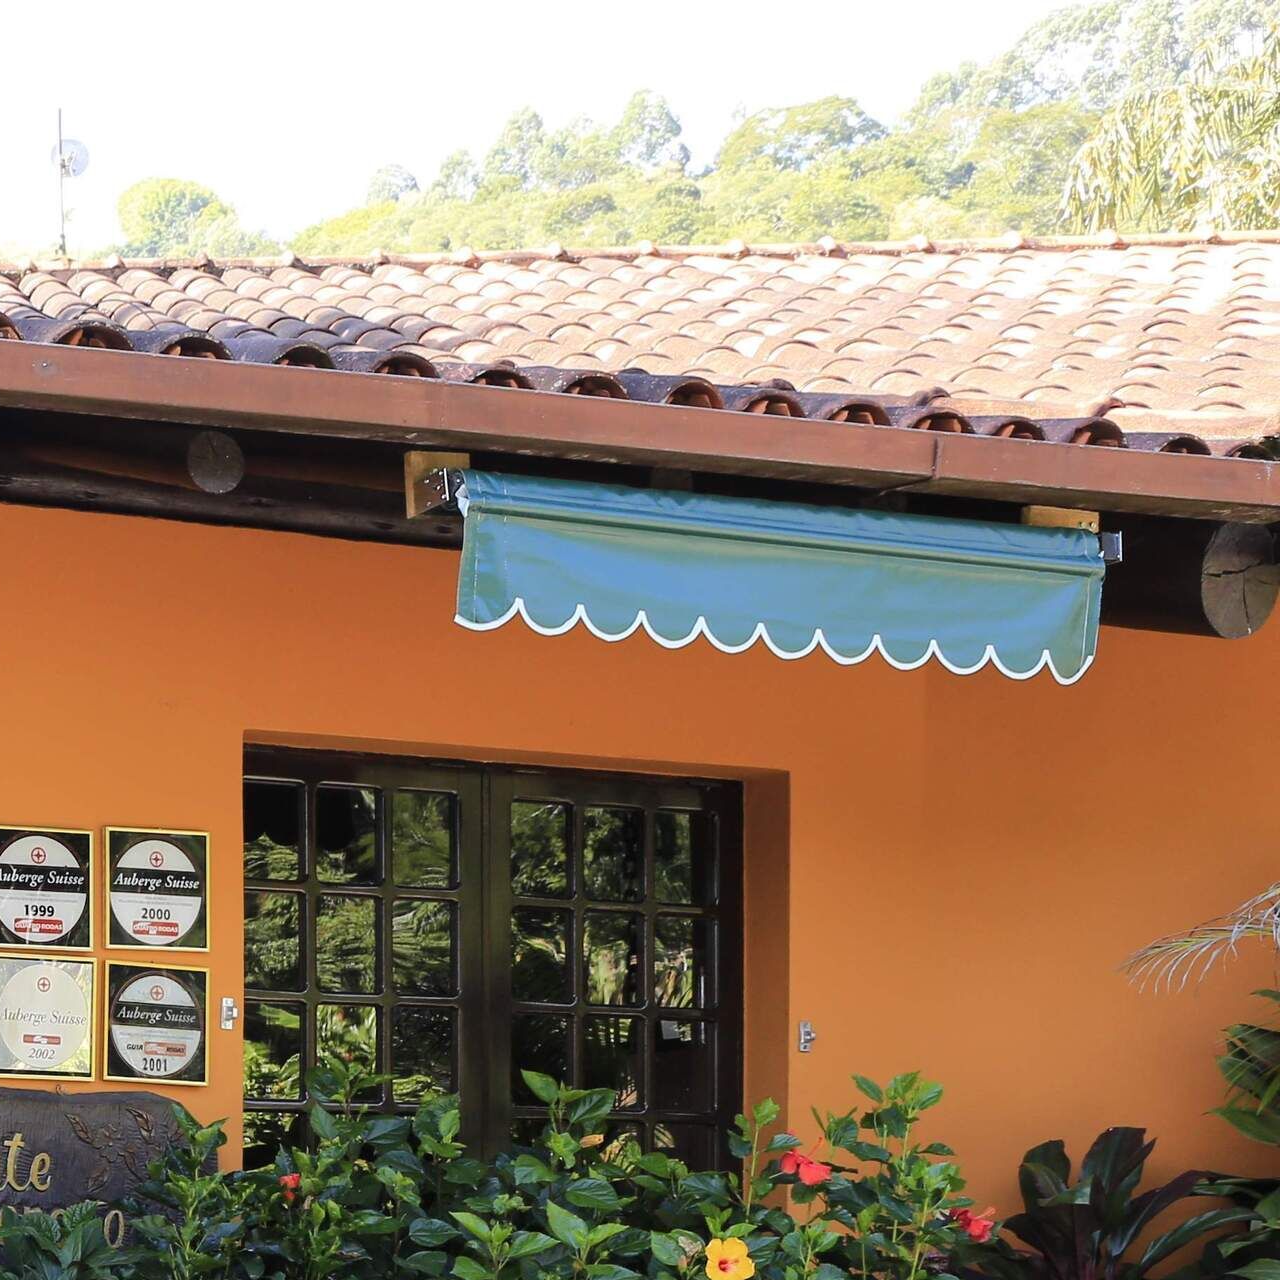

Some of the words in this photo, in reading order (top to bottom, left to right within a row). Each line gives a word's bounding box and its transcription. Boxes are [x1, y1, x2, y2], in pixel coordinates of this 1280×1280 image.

[47, 871, 85, 885] Suisse
[113, 873, 162, 890] Auberge
[165, 875, 200, 889] Suisse
[24, 904, 55, 917] 1999
[142, 908, 171, 920] 2000
[1, 1007, 47, 1026] Auberge
[50, 1010, 87, 1026] Suisse
[117, 1006, 162, 1024] Auberge
[164, 1009, 197, 1023] Suisse
[28, 1047, 56, 1060] 2002
[142, 1057, 168, 1072] 2001
